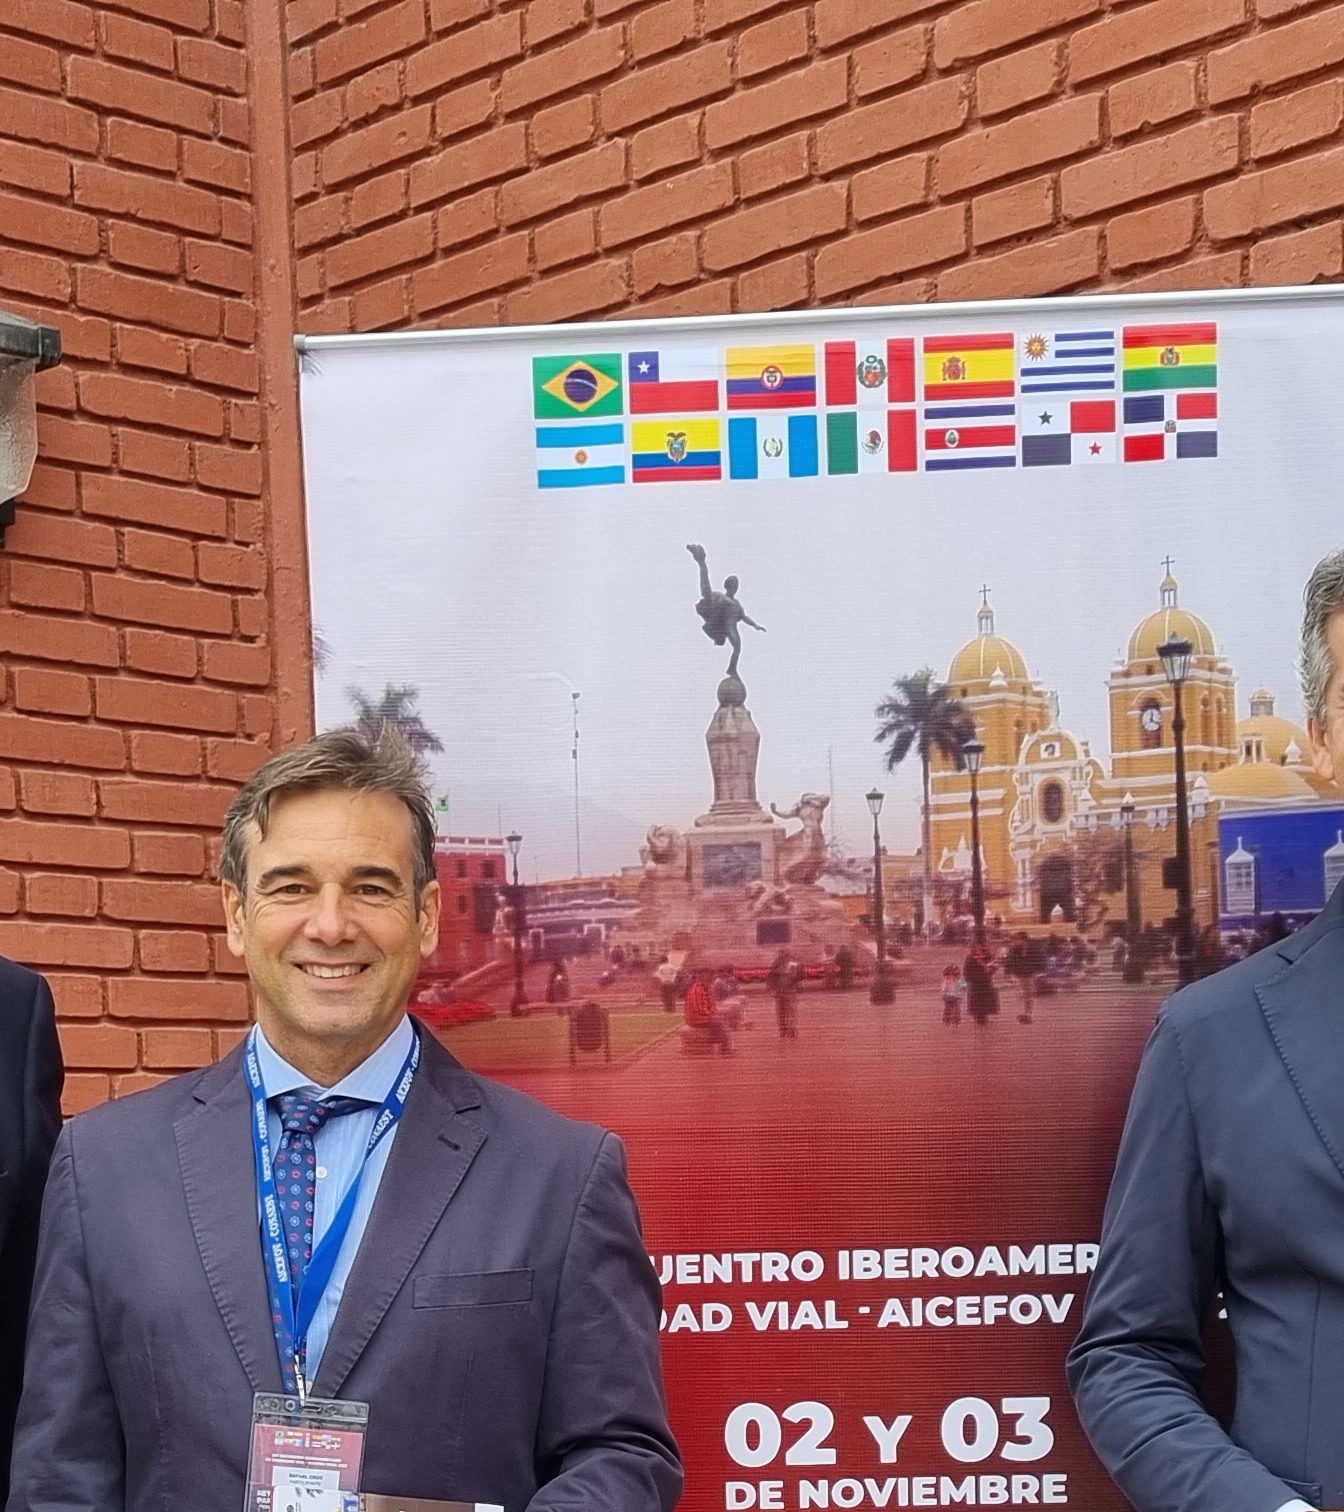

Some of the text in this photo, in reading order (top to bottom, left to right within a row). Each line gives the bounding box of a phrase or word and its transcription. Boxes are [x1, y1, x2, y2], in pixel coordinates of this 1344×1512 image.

[838, 1243, 1101, 1281] IBEROAMER
[744, 1300, 849, 1331] VIAL
[858, 1306, 871, 1314] -
[878, 1292, 1075, 1329] AICEFOV
[724, 1396, 1055, 1468] 02 Y 03
[725, 1473, 1068, 1511] DE NOVIEMBRE
